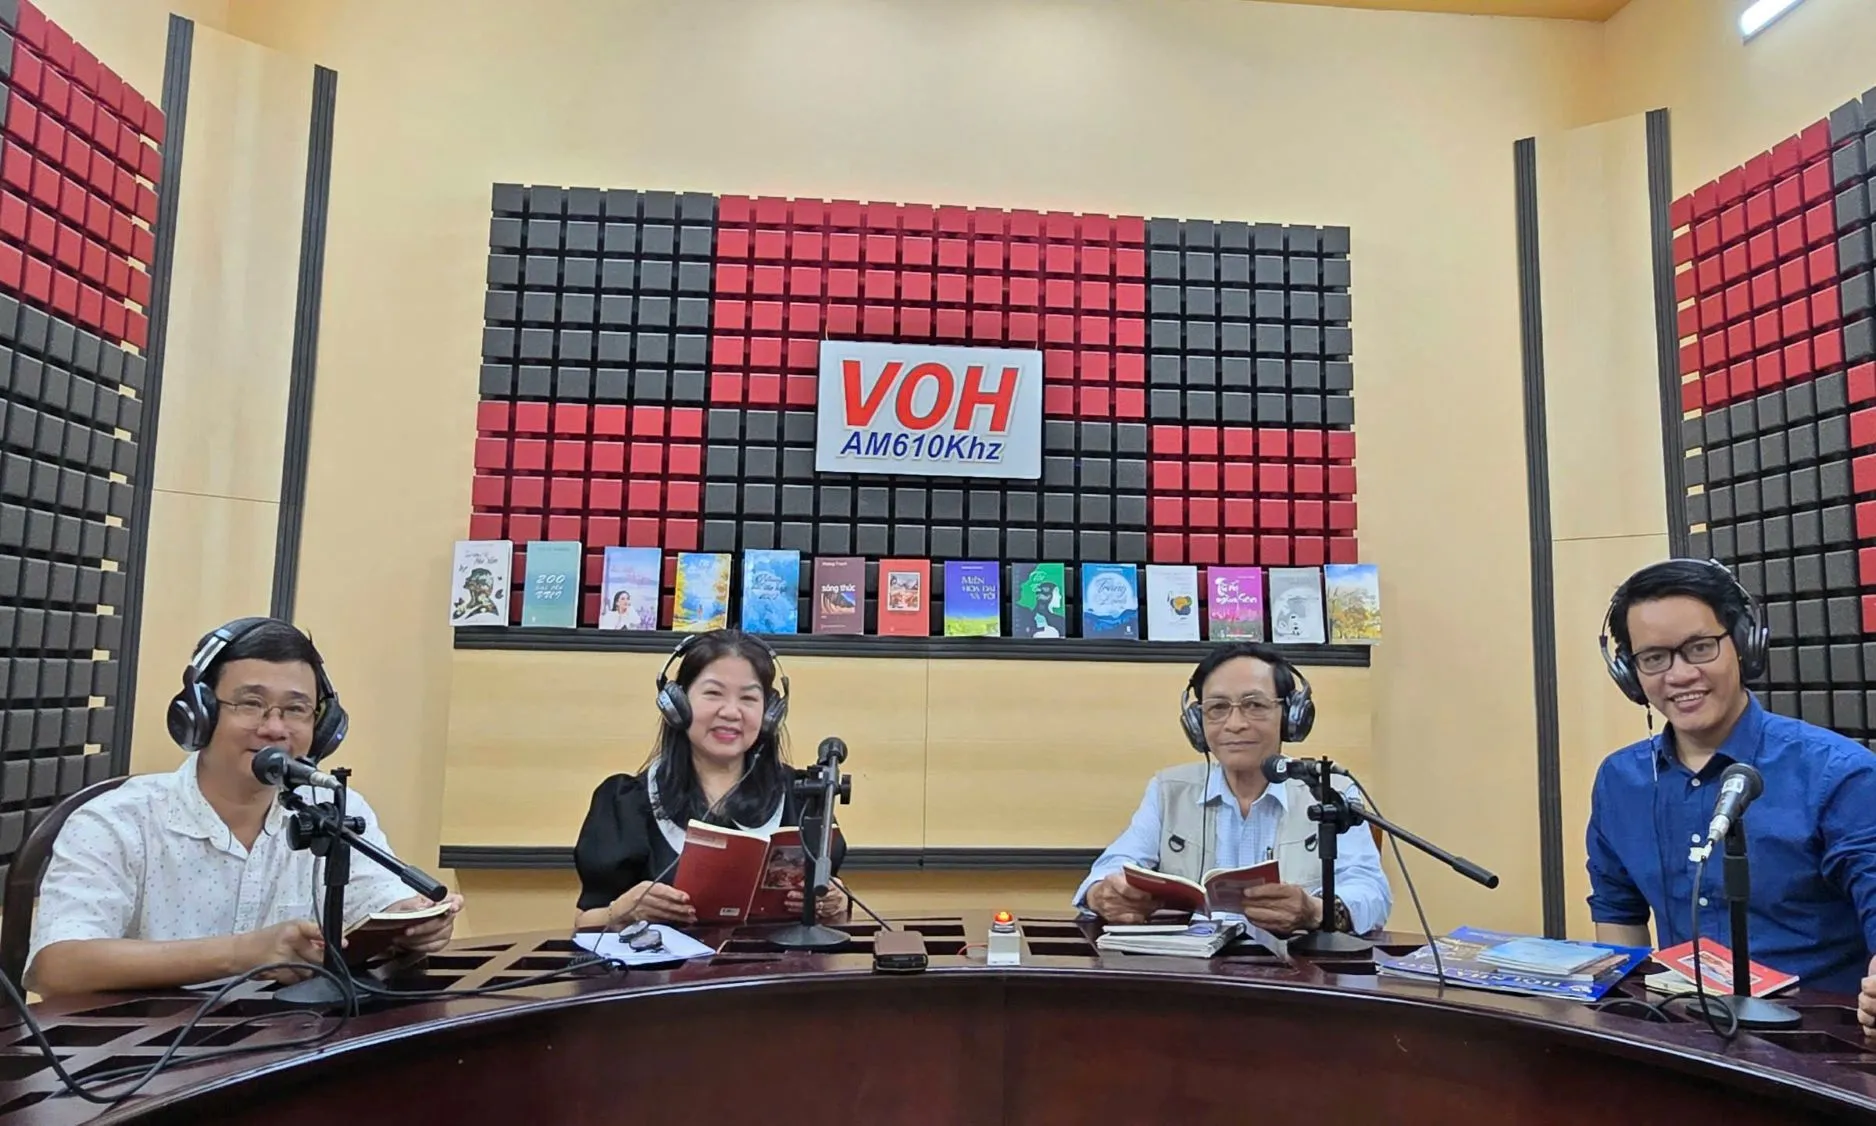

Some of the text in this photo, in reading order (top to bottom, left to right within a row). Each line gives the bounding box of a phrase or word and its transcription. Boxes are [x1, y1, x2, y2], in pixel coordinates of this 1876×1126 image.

[841, 359, 1019, 433] VOH
[840, 431, 1003, 460] AM610Khz
[536, 574, 566, 584] 200
[821, 584, 839, 594] sóng
